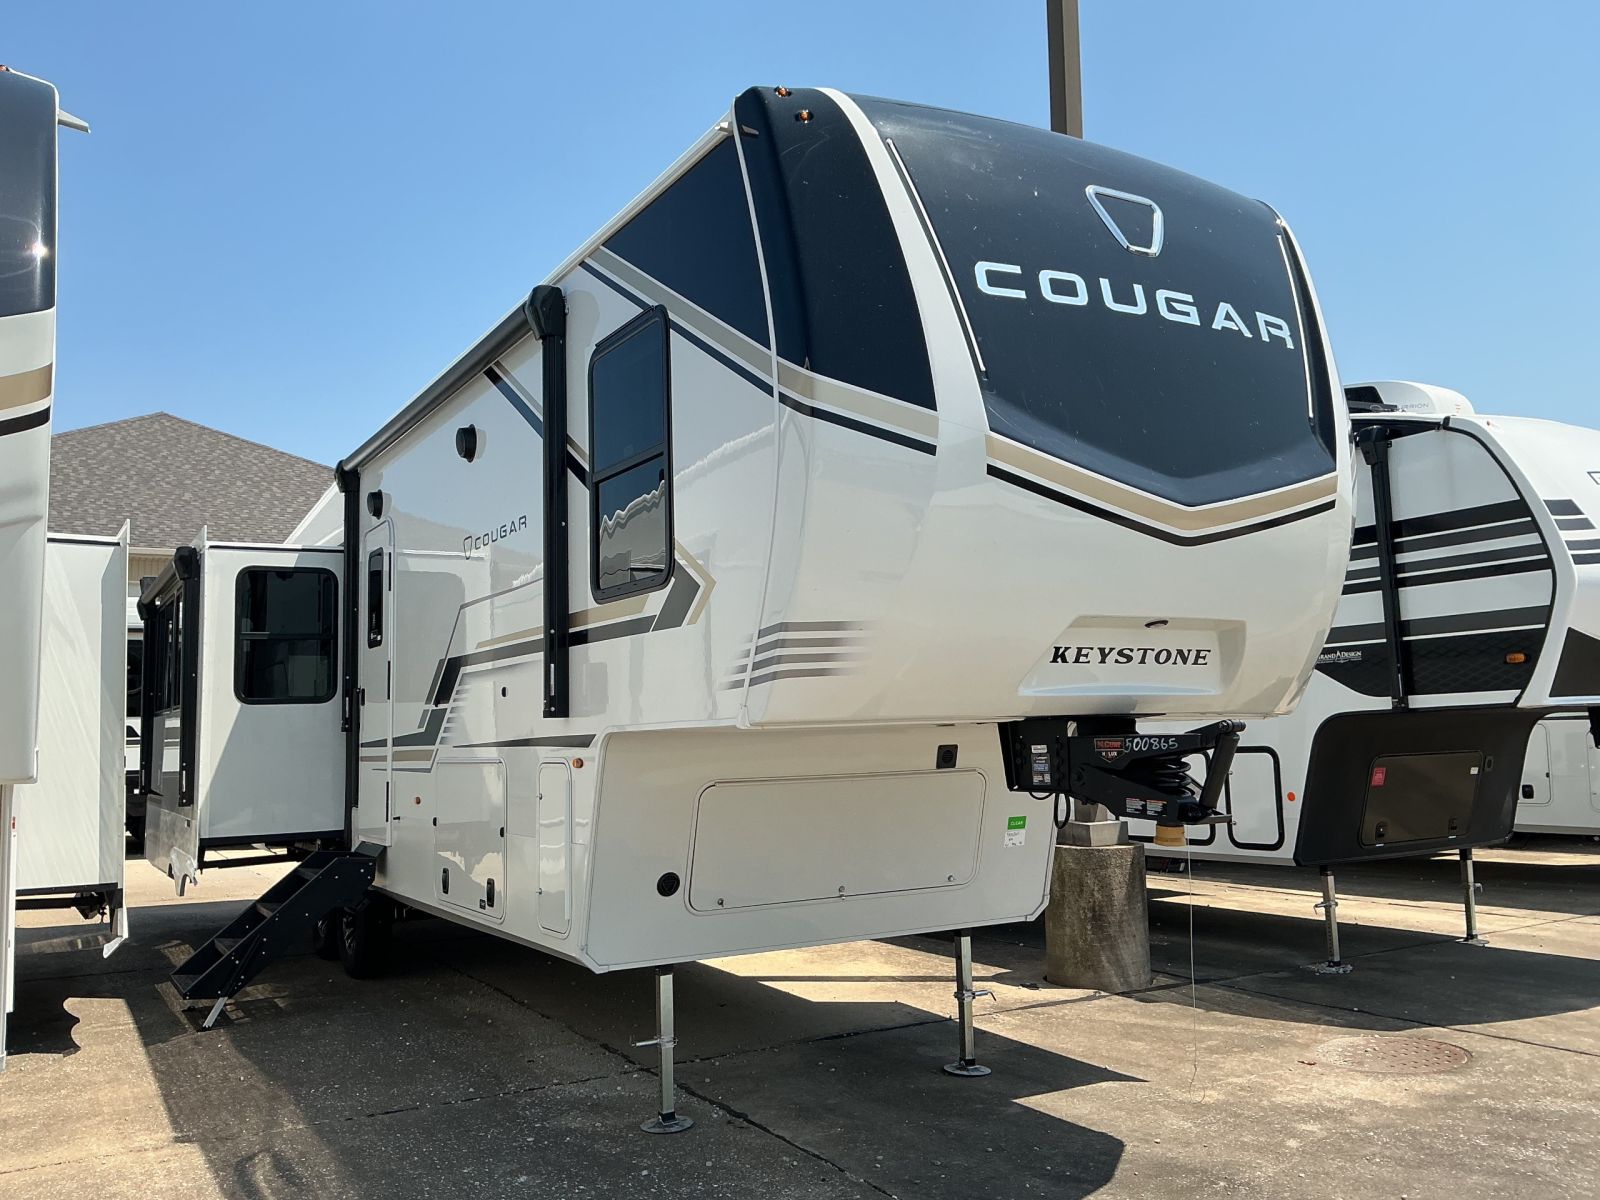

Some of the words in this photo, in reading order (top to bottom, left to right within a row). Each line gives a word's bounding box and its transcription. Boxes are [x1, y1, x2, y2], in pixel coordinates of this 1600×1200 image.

[974, 260, 1295, 350] COUGAR
[474, 515, 527, 550] COUGAR
[1049, 646, 1212, 666] KEYSTONE
[1341, 650, 1362, 658] DESIGN
[1124, 737, 1179, 753] 500865
